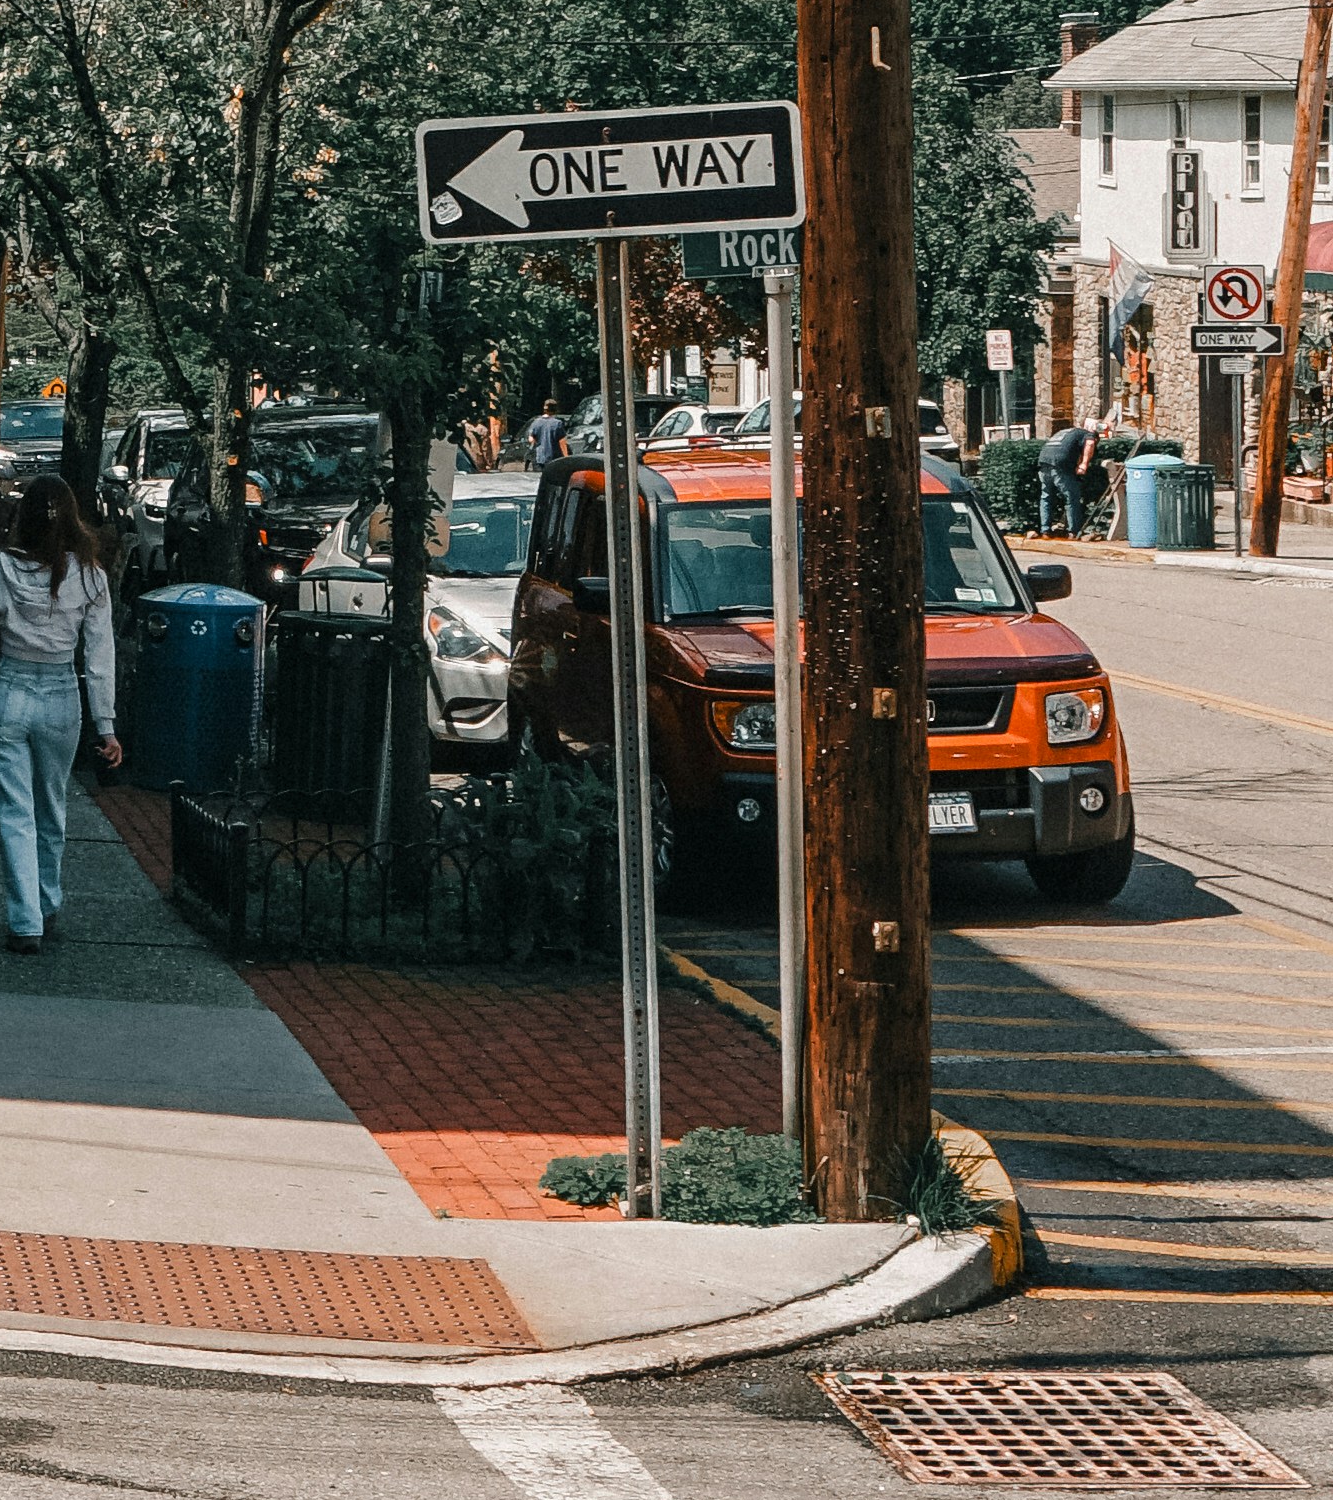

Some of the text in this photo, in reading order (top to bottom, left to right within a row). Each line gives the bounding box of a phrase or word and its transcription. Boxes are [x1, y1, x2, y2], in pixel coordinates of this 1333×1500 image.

[529, 139, 755, 197] ONE WAY
[1199, 333, 1255, 346] ONE WAY
